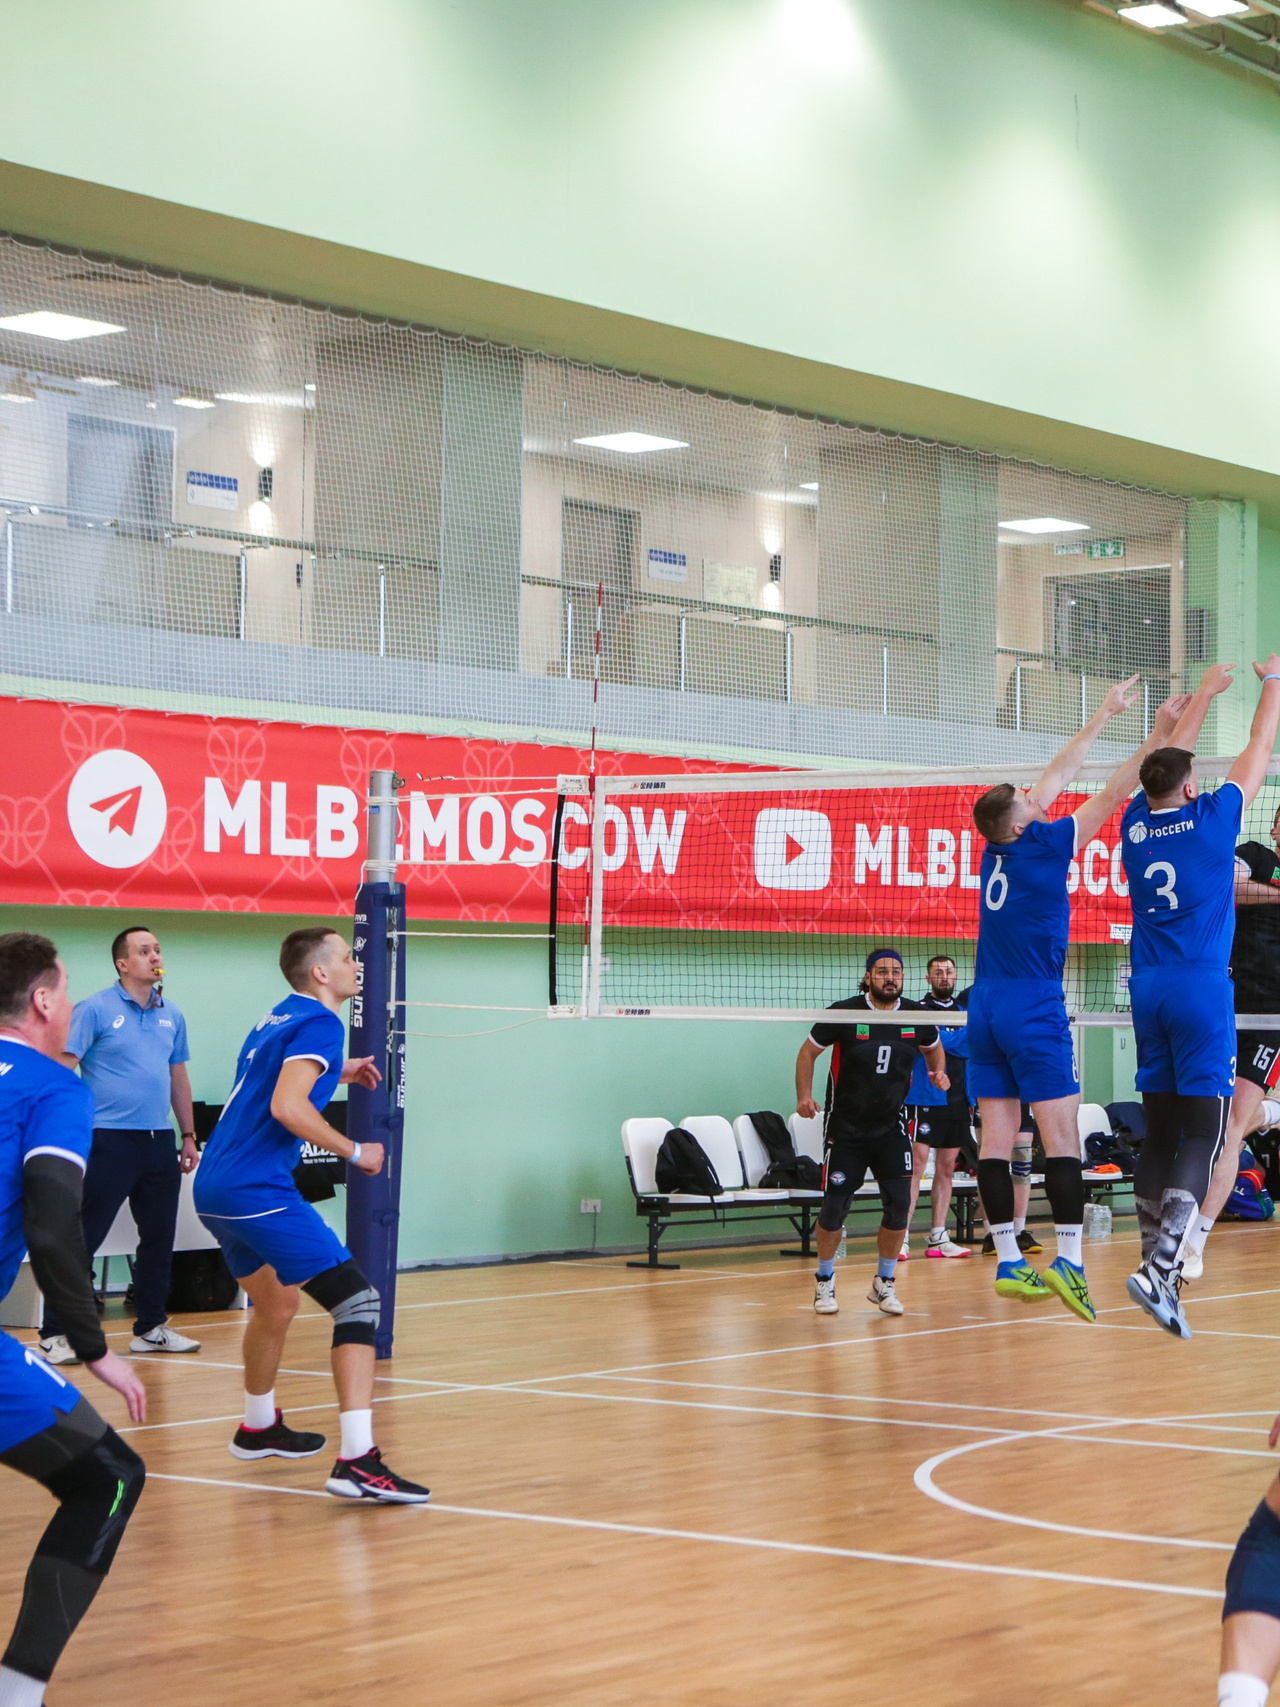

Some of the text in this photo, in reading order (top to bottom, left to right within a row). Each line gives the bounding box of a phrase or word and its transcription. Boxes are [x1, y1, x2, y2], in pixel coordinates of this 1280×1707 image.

[204, 777, 688, 875] MLBMOSCOW
[1149, 819, 1195, 839] РОССЕТИ
[985, 854, 1009, 911] 6
[1143, 861, 1179, 913] 3
[876, 1045, 892, 1074] 9
[1252, 1044, 1275, 1071] 15
